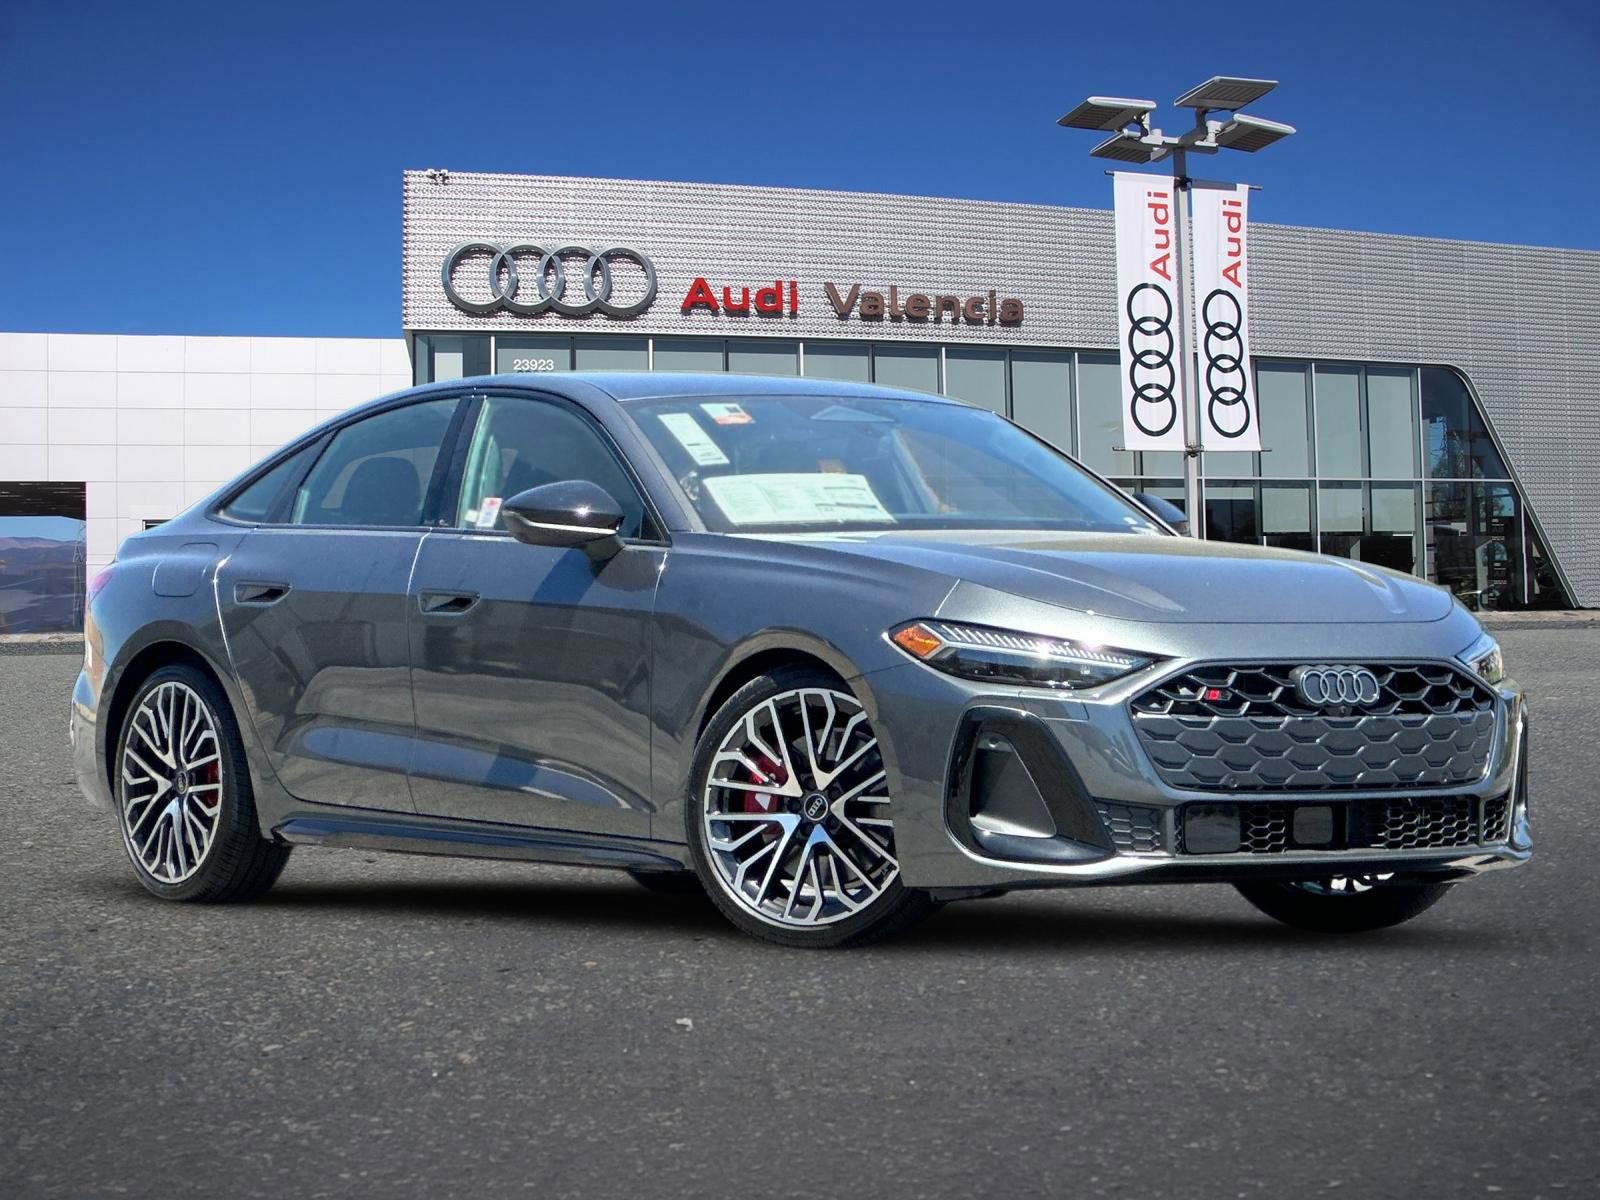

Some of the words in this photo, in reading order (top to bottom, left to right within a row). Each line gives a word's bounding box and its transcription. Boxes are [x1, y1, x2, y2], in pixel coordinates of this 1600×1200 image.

[1148, 191, 1171, 281] Audi
[1222, 200, 1242, 288] Audi
[682, 277, 798, 317] Audi
[825, 282, 1024, 325] Valencia
[513, 359, 554, 371] 23923
